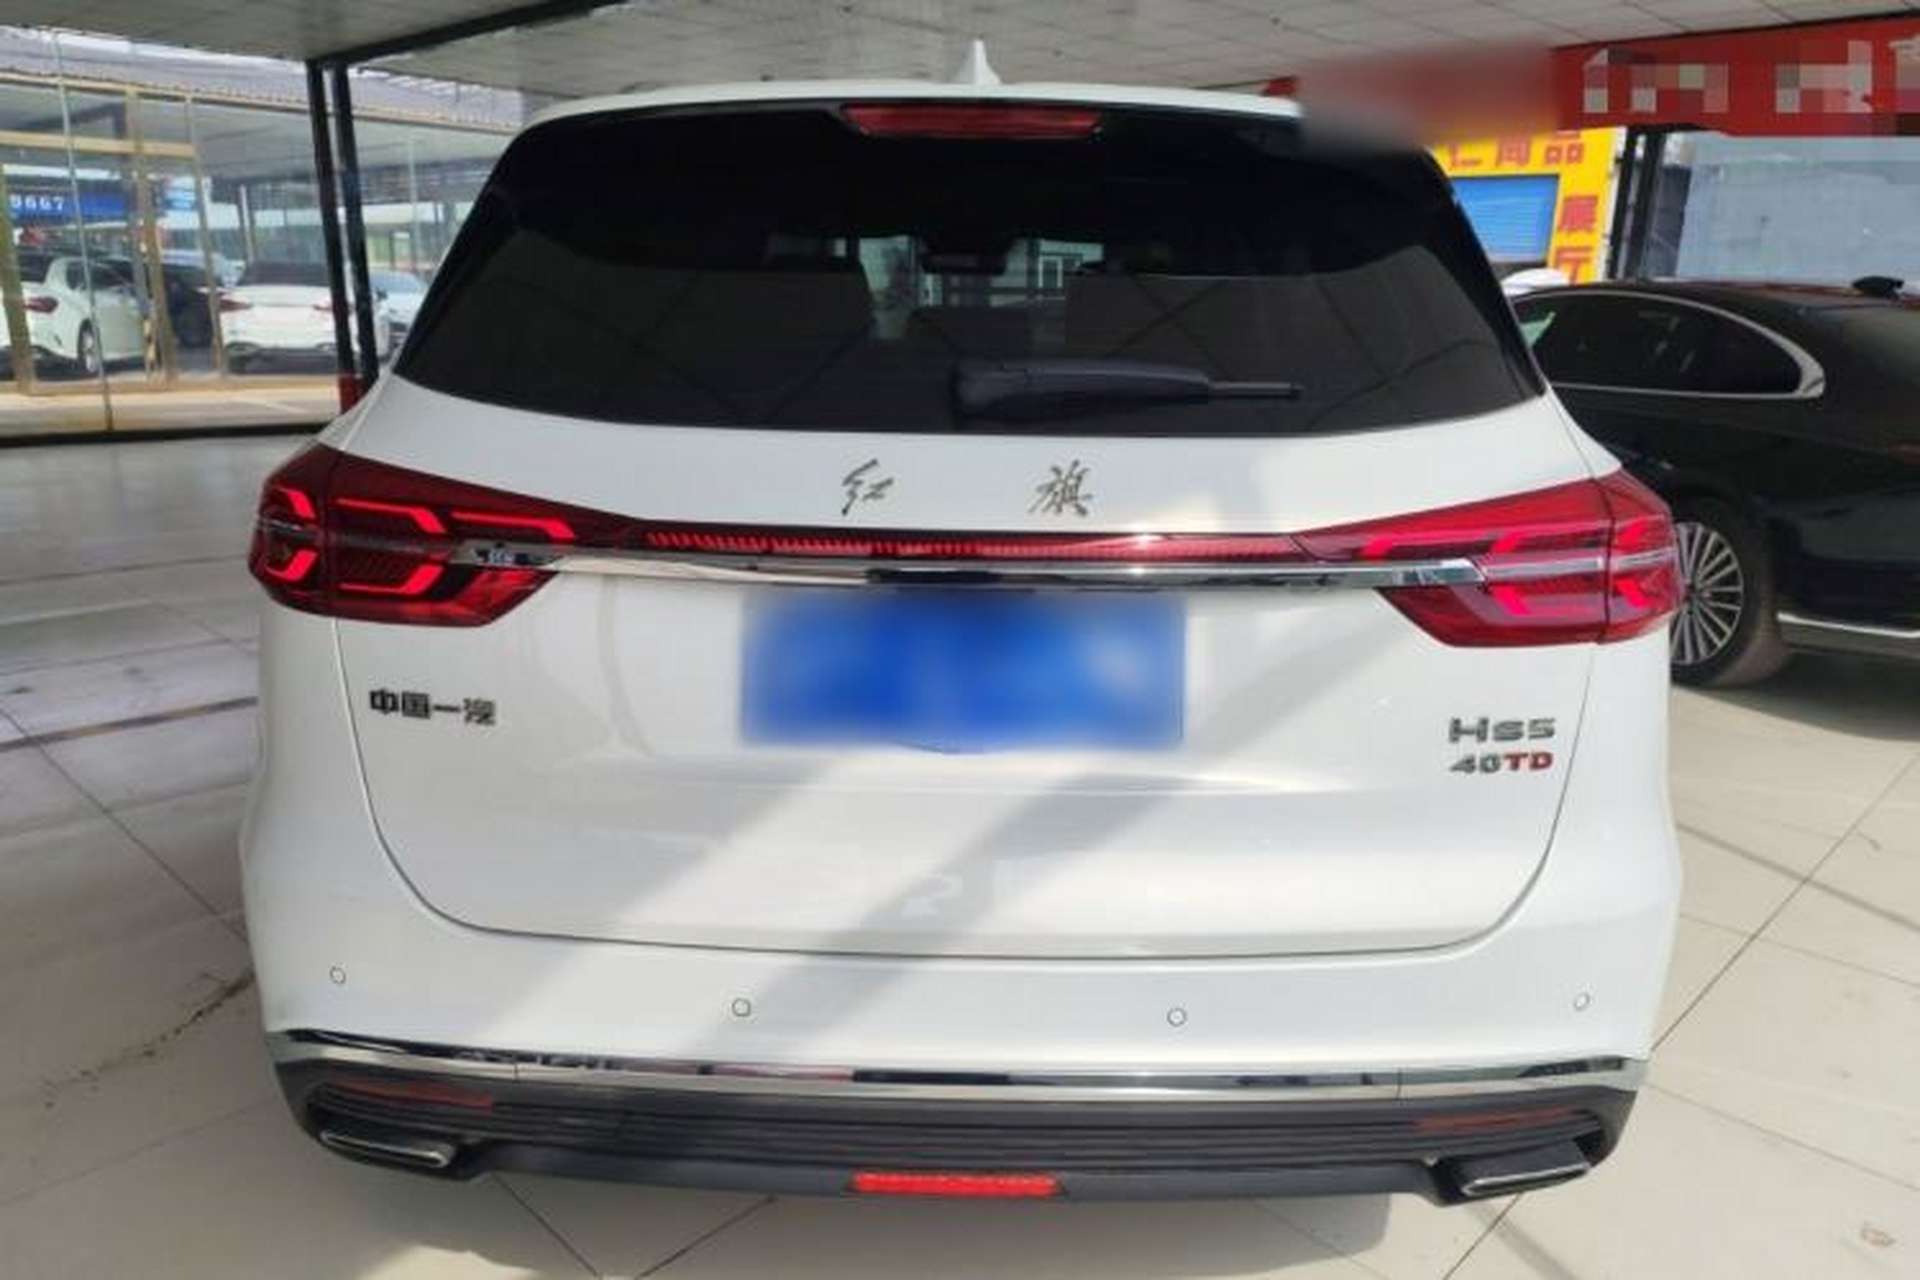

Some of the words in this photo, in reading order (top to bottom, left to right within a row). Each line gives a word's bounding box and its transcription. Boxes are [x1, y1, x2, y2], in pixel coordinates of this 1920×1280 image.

[369, 689, 497, 725] 中国一汽
[1449, 717, 1556, 743] HS5
[1449, 751, 1554, 774] 40TD
